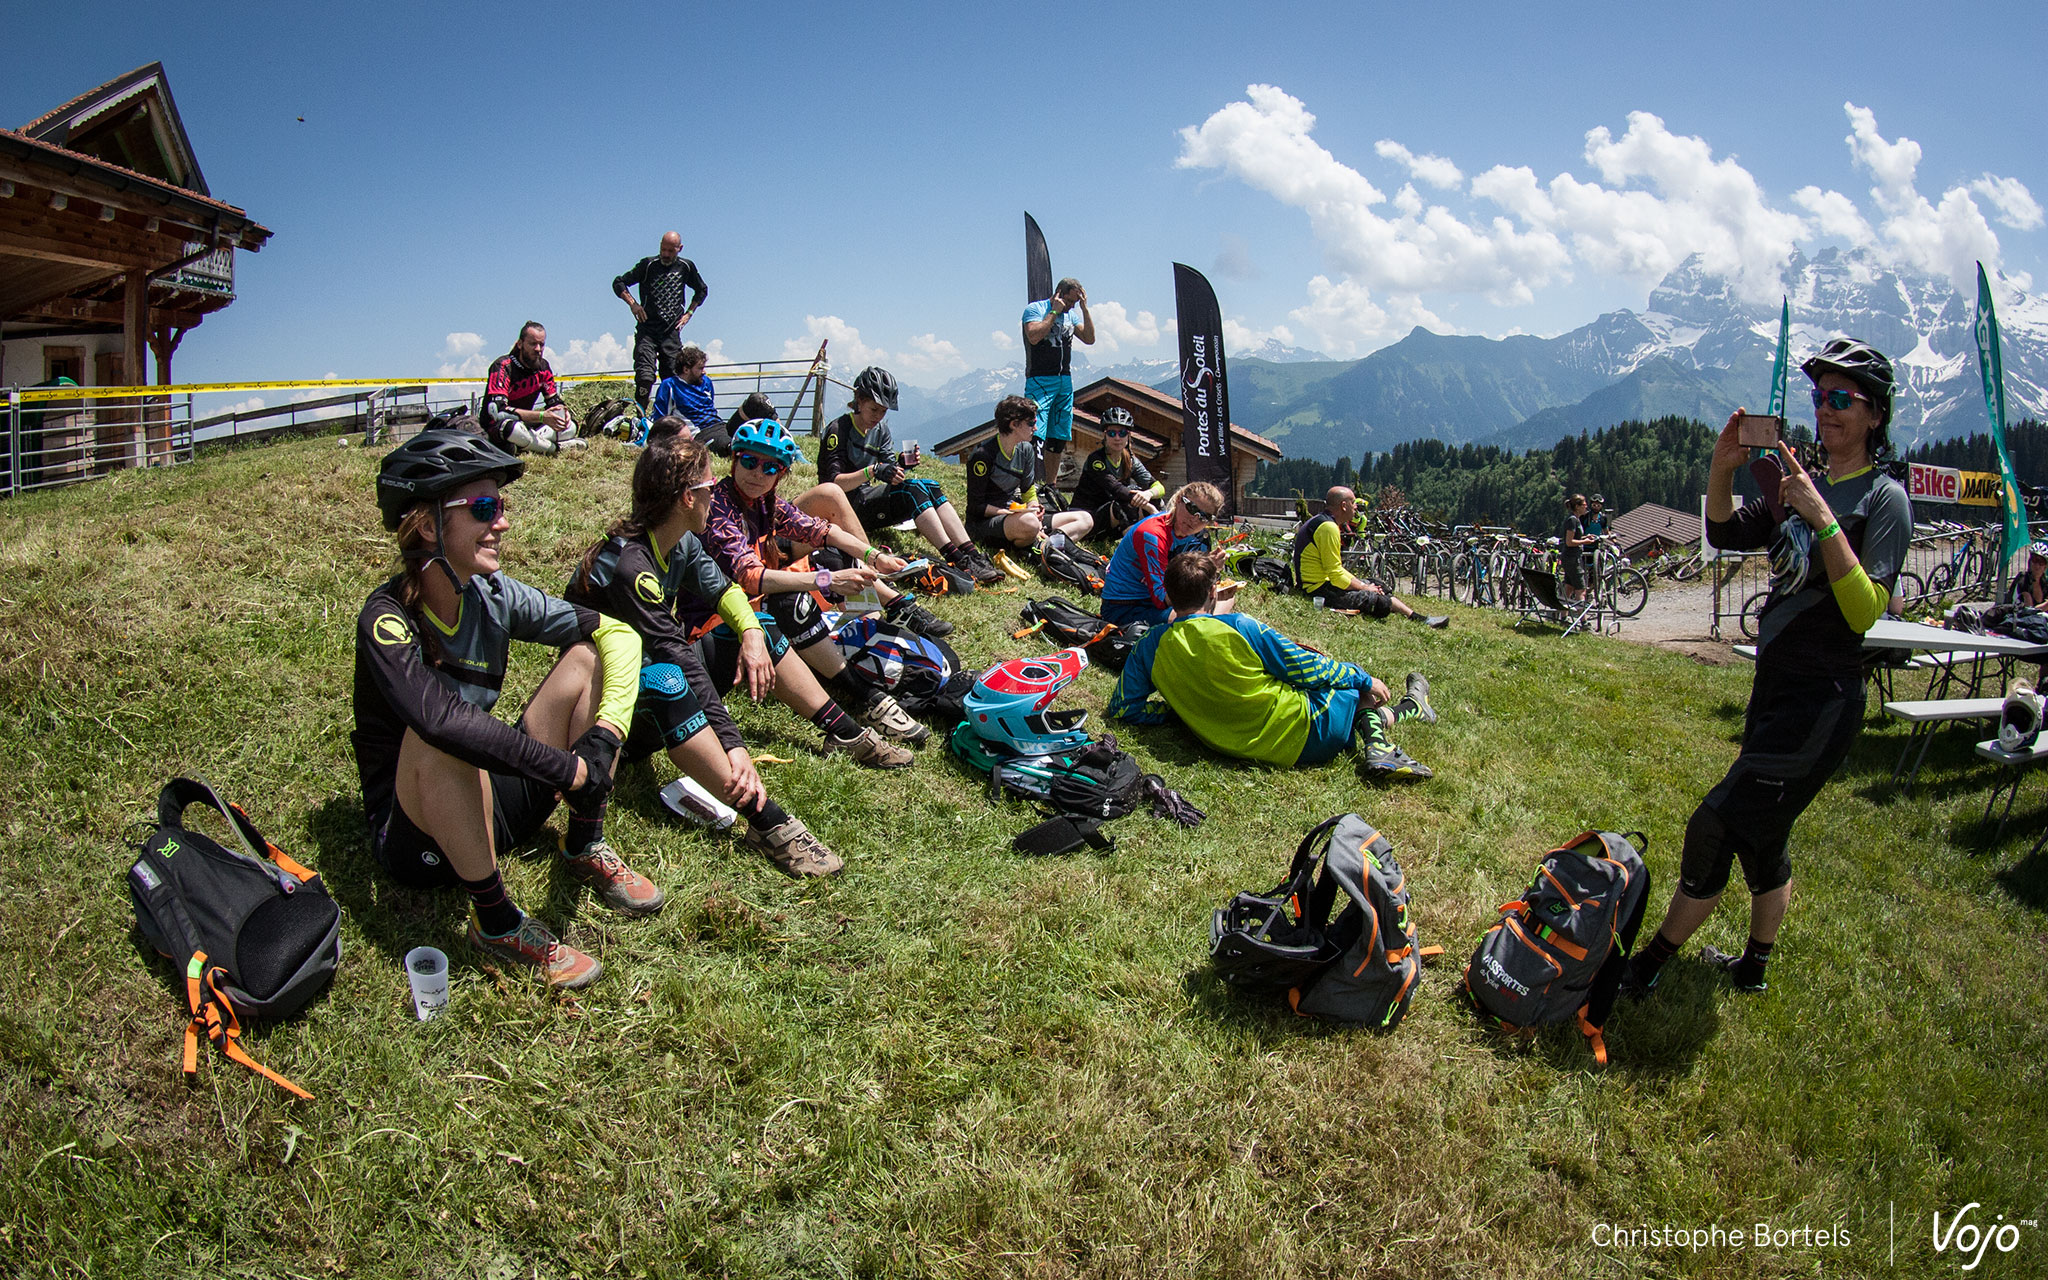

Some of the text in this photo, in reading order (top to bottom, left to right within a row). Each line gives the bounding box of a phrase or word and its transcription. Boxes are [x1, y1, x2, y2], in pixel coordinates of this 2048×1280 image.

[1186, 335, 1214, 457] Portes du Soleil
[1914, 466, 1956, 499] Bike
